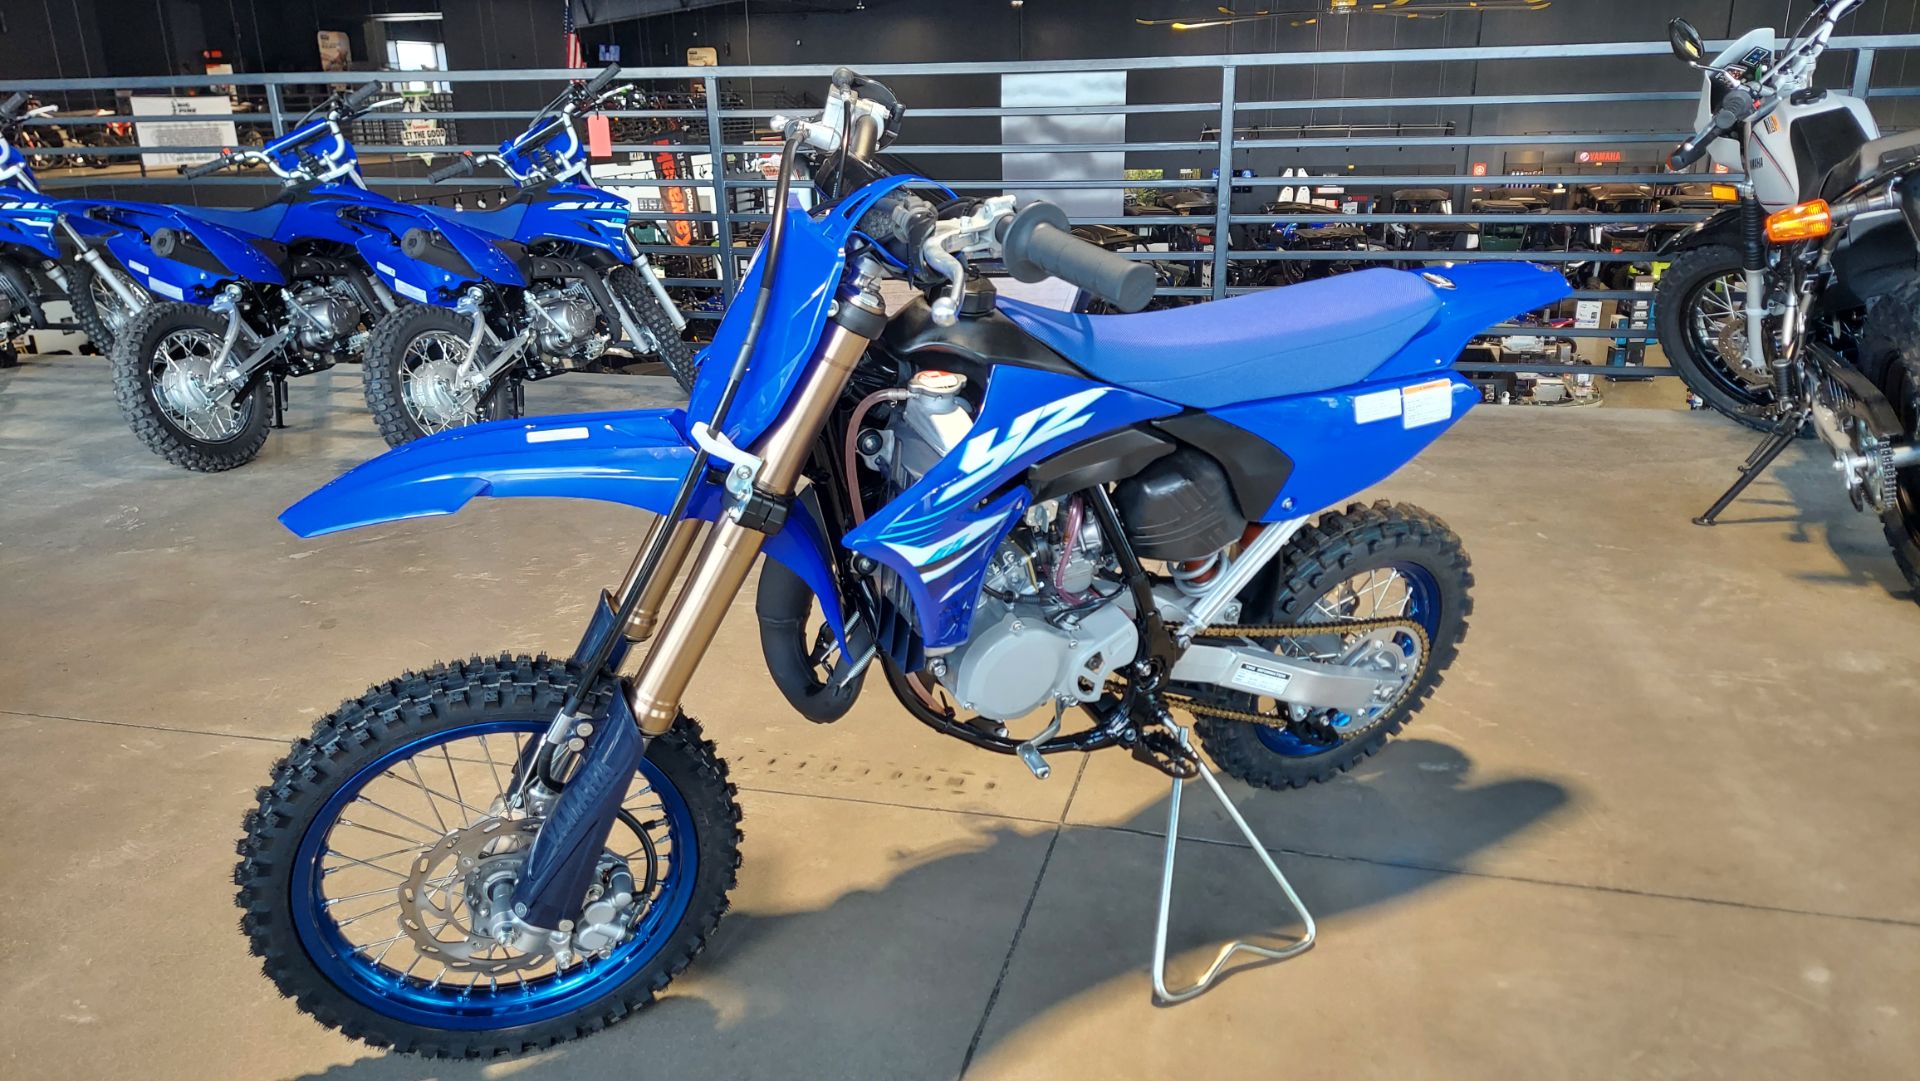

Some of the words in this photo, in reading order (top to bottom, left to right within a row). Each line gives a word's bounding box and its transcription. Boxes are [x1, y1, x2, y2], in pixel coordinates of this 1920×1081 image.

[414, 131, 426, 139] THE
[427, 129, 445, 138] GOOD
[1590, 152, 1621, 161] YAMAHA
[545, 760, 612, 844] YAMAHA
